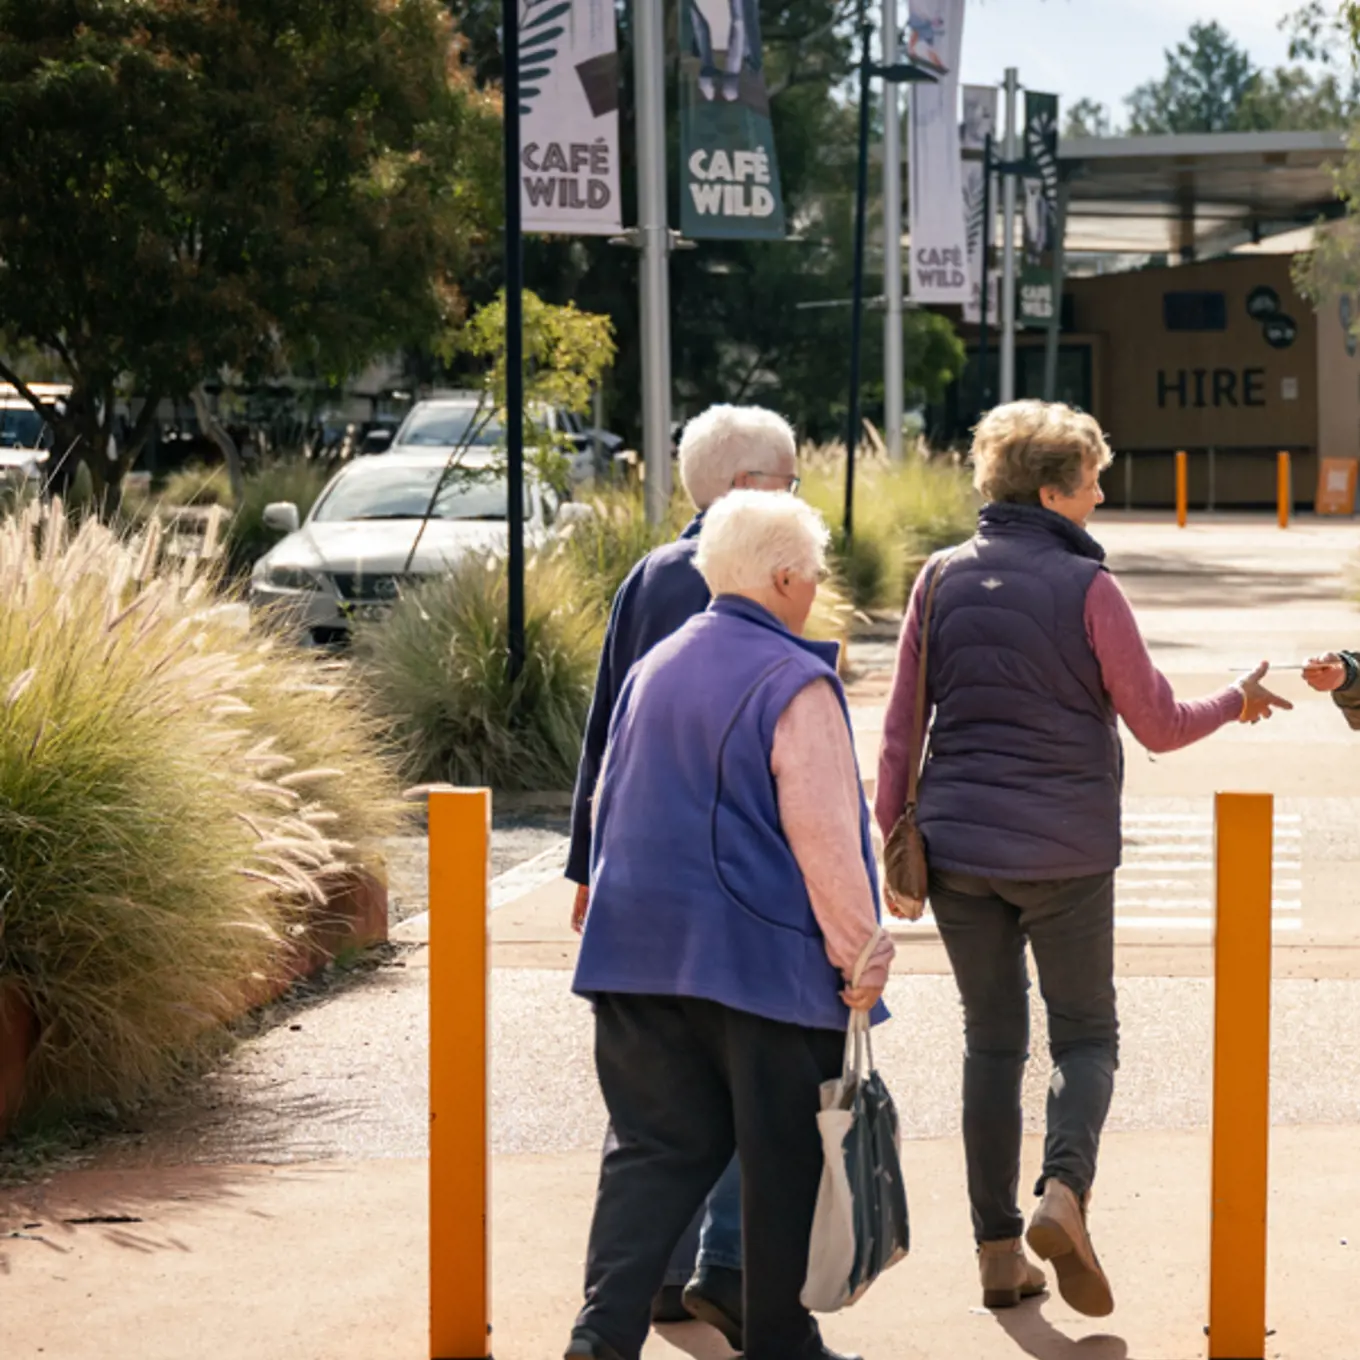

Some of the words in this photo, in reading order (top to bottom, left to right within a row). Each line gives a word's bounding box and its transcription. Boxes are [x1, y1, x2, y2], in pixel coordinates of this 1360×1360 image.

[521, 137, 609, 175] CAFÉ
[689, 146, 770, 186] CAFÉ
[521, 176, 611, 212] WILD
[690, 183, 775, 216] WILD
[916, 244, 962, 267] CAFÉ
[917, 269, 965, 288] WILD
[1157, 367, 1265, 408] HIRE
